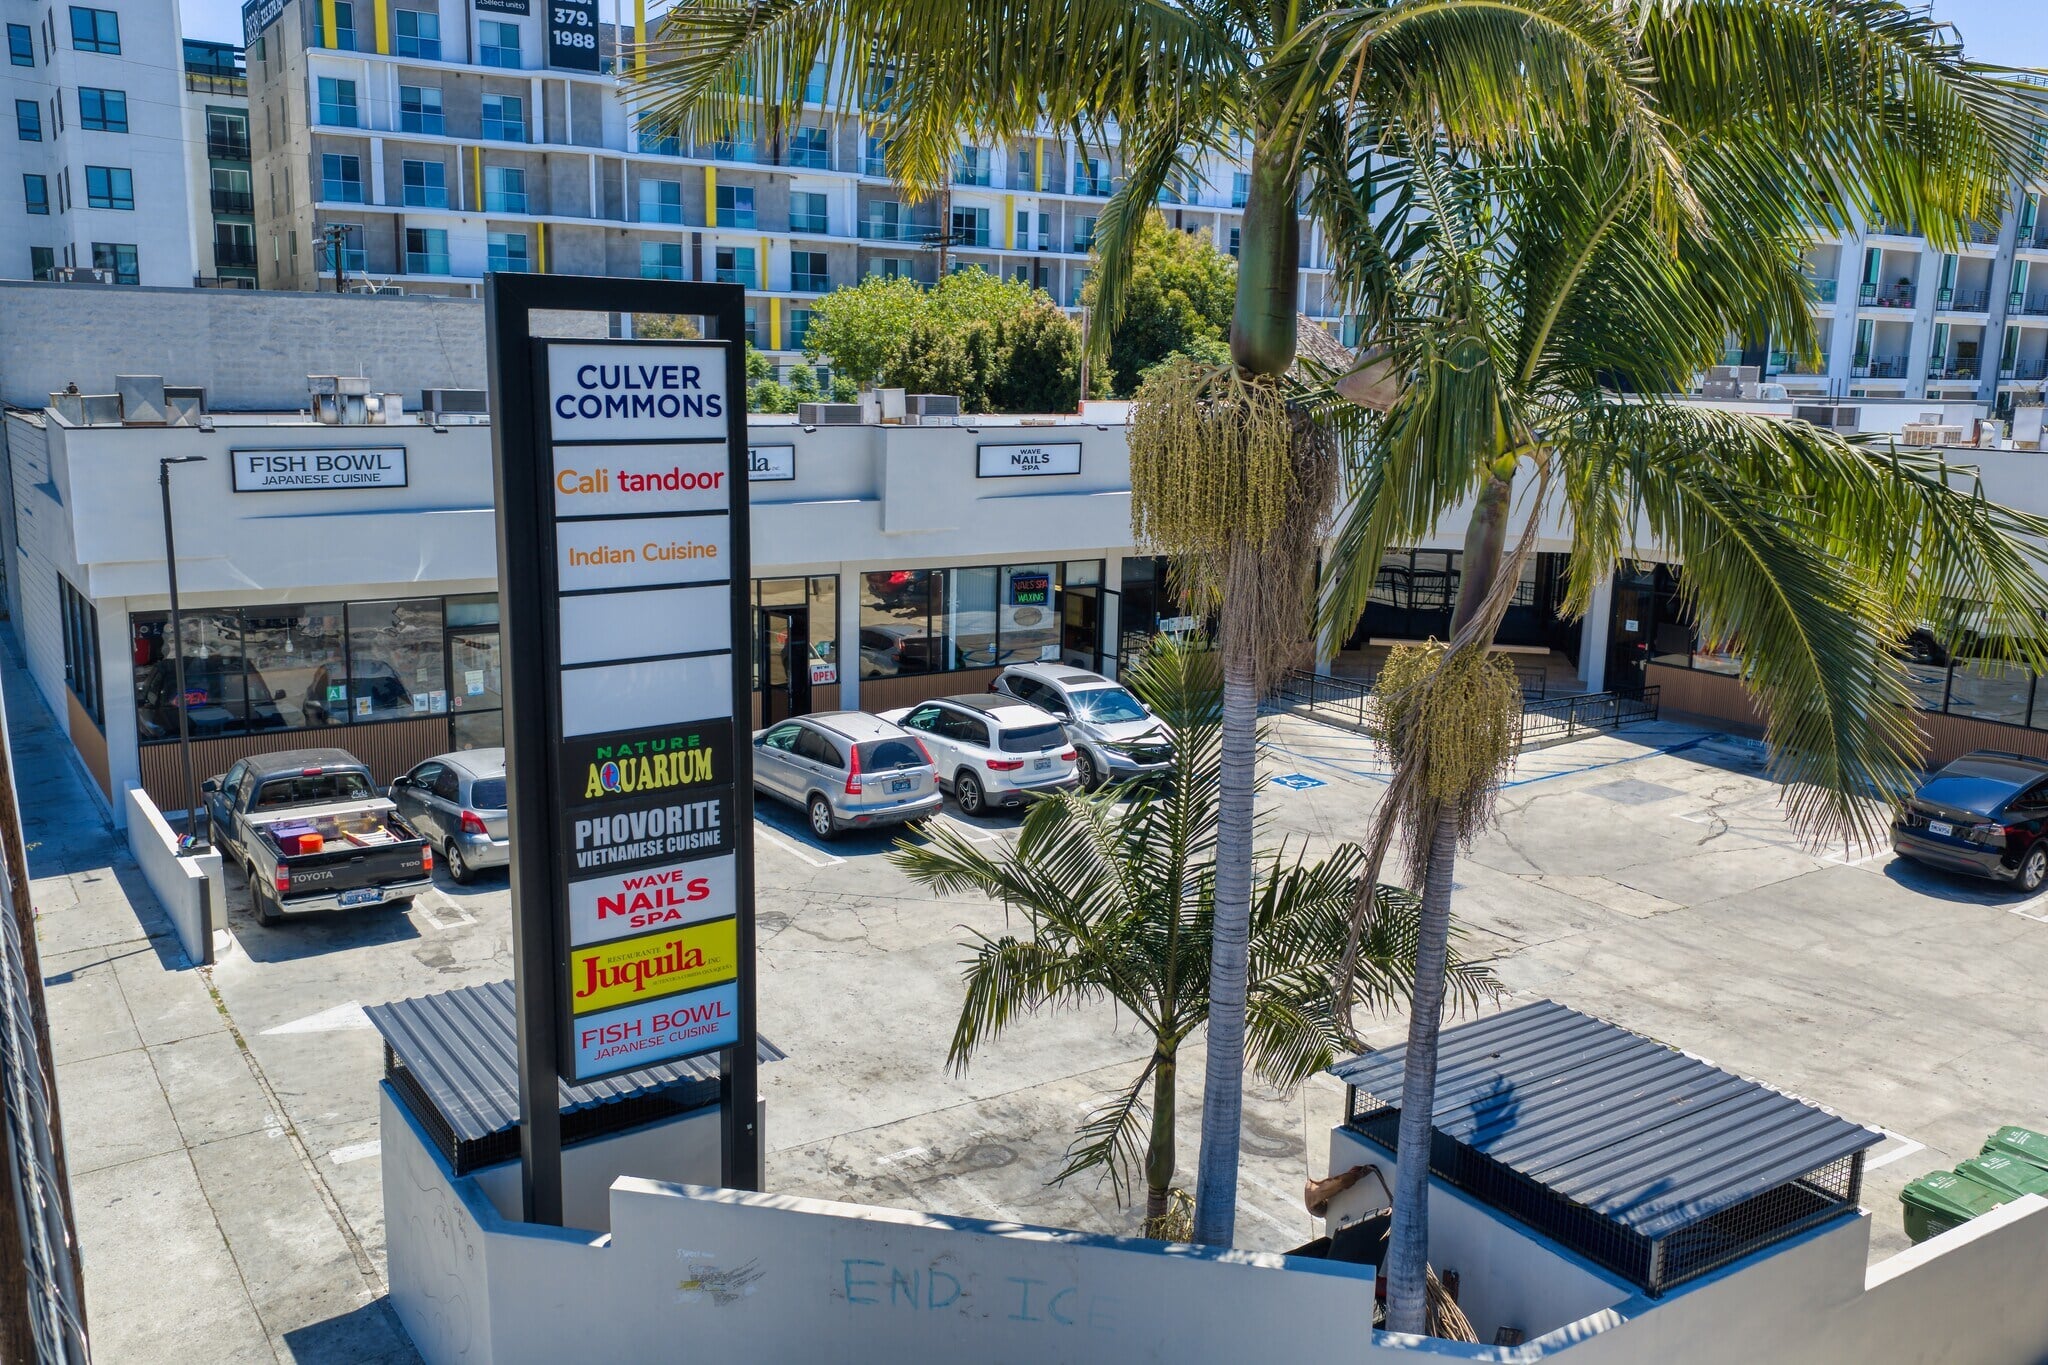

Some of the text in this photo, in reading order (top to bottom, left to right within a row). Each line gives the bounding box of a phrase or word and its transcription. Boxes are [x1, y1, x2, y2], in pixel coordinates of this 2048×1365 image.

[554, 8, 593, 27] 379.
[553, 30, 595, 49] 1988
[577, 365, 702, 390] CULVER
[555, 394, 722, 420] COMMONS
[249, 454, 391, 473] FISH BOWL
[1011, 454, 1050, 465] NAILS
[262, 473, 381, 486] JAPANESE CUISINE
[556, 467, 725, 494] Cali tandoor
[569, 541, 718, 567] Indian Cuisine
[1017, 592, 1045, 602] WAXING
[813, 670, 836, 682] OPEN
[597, 734, 700, 760] NATURE
[584, 747, 713, 799] AQUARIUM
[575, 799, 721, 850] PHOVORITE
[576, 829, 721, 869] VIETNAMESE CUISINE
[292, 870, 334, 883] TOYOTA
[401, 860, 420, 868] T100
[622, 869, 684, 891] WAVE
[597, 878, 711, 920] NAILS
[629, 908, 683, 928] SPA
[607, 947, 662, 964] RESTAURANTE
[575, 939, 707, 998] Juquila
[581, 1001, 731, 1049] FISH BOWL
[594, 1021, 720, 1061] JAPANESE CUISINE
[842, 1258, 961, 1310] END
